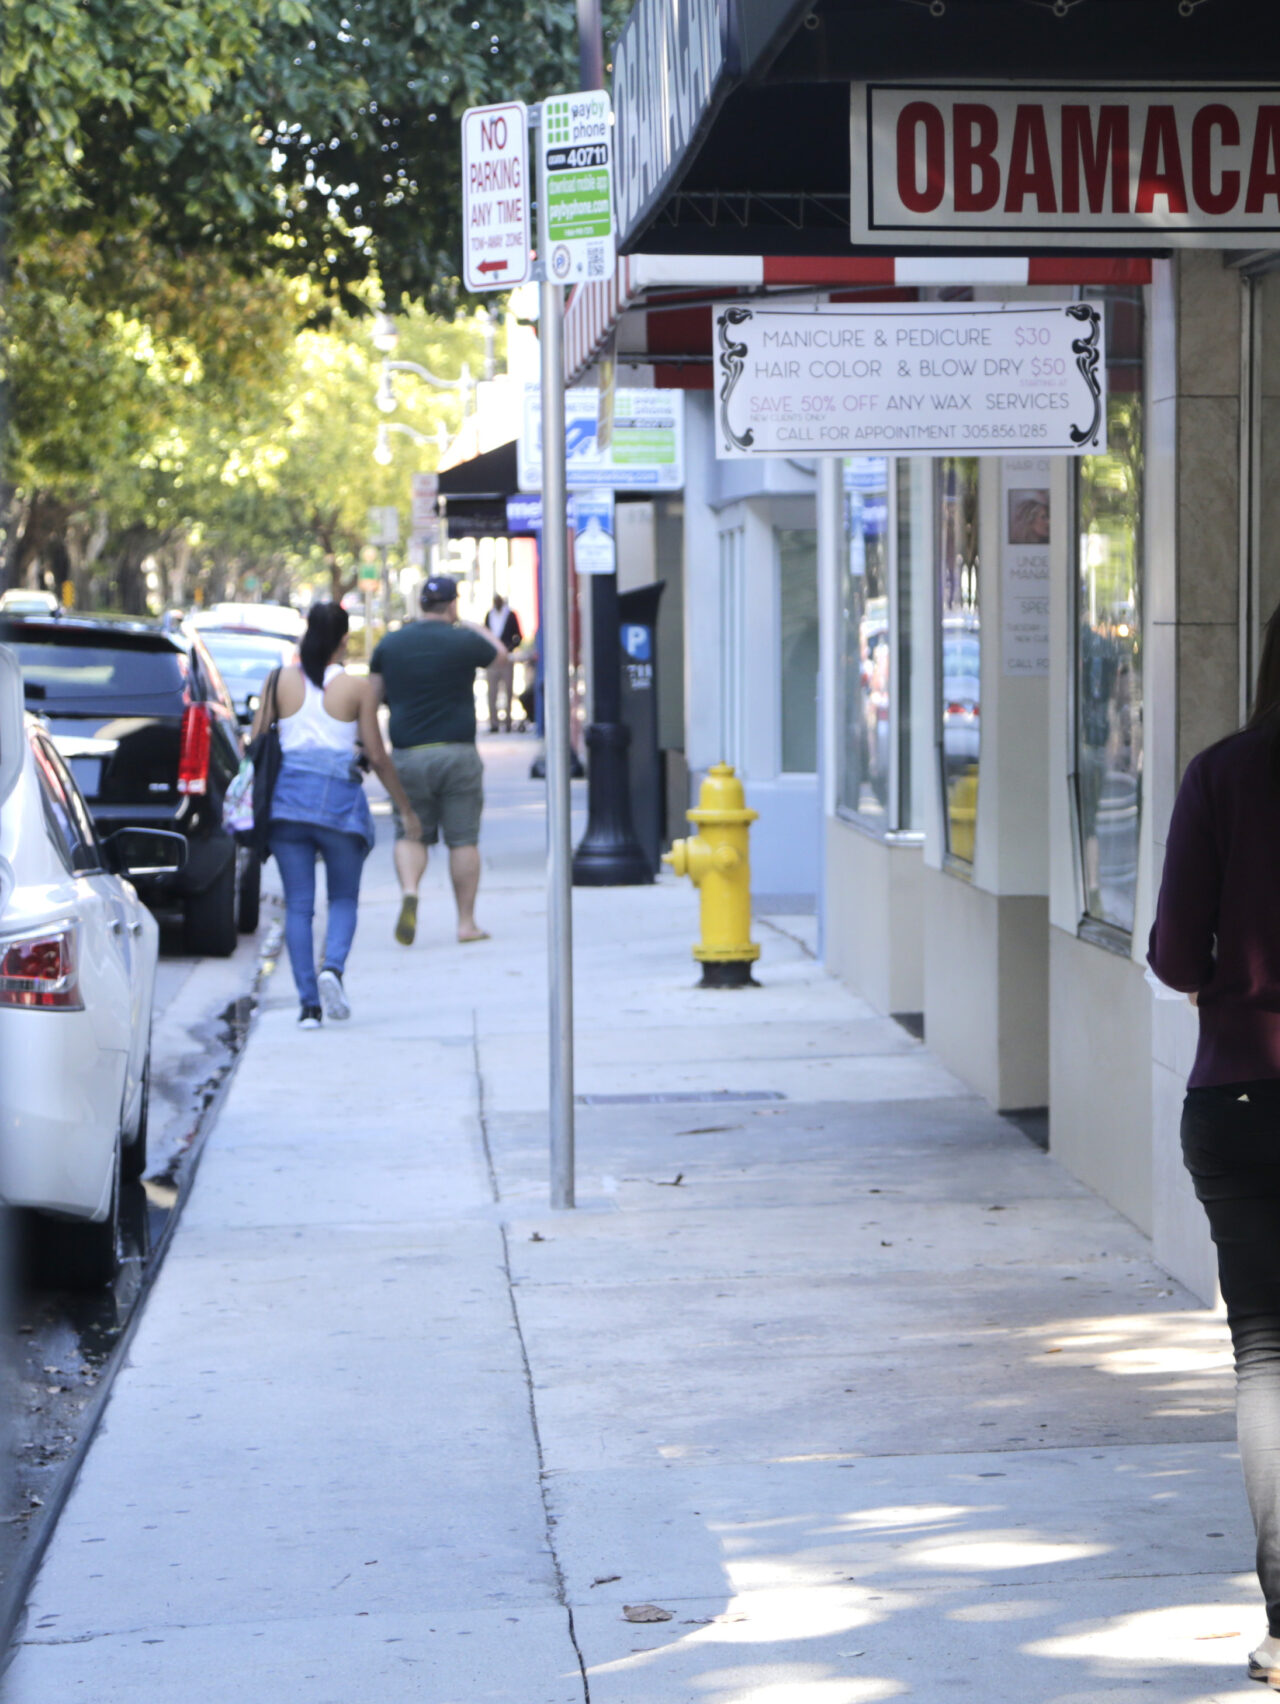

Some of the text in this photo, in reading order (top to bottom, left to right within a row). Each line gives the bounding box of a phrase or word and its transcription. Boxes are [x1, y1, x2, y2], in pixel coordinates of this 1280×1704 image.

[481, 117, 507, 151] NO
[573, 121, 606, 141] phone
[567, 146, 606, 167] 40711
[470, 157, 520, 193] PARKING
[471, 199, 522, 228] ANY TIME
[471, 232, 523, 251] TOW-AWAY ZONE
[762, 326, 1051, 348] MANICURE & PEDICURE $30
[754, 356, 1066, 378] HAIR COLOR & BLOW DRY $50
[749, 393, 1070, 413] SAVE 50% OFF ANY WAX SERVICES
[776, 426, 814, 441] CALL
[820, 426, 850, 440] FOR
[854, 424, 955, 440] APPOINTMENT
[627, 626, 647, 656] P
